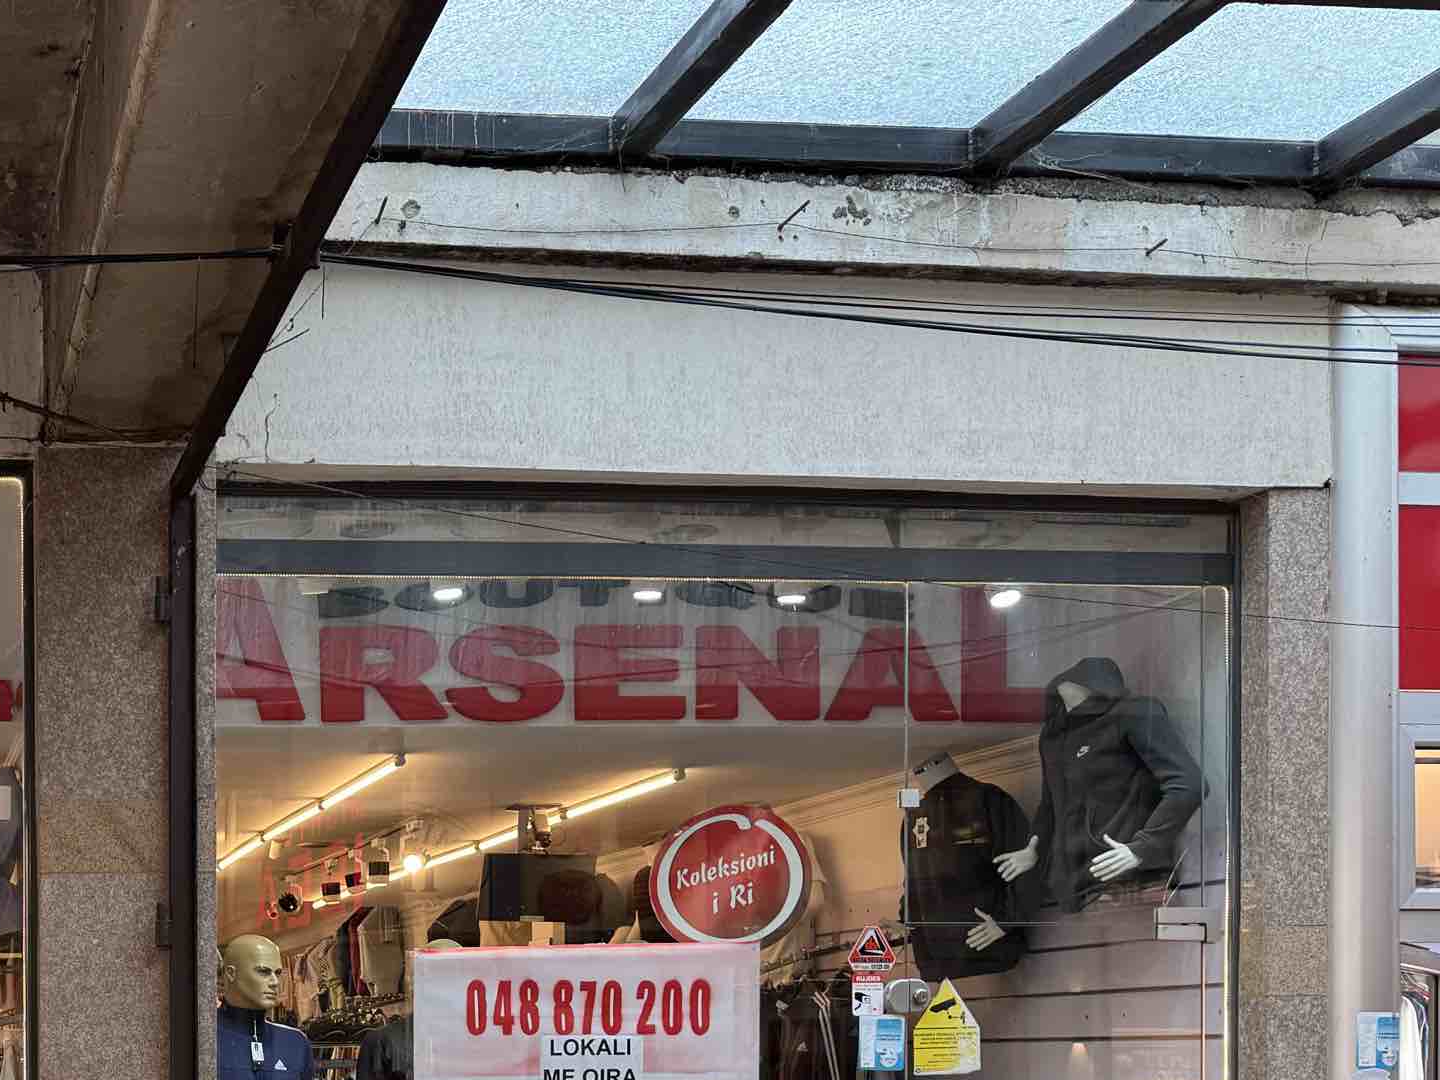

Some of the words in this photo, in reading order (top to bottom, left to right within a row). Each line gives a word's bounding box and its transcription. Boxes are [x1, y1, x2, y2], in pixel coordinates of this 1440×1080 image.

[319, 579, 914, 621] BOUTQUE
[216, 576, 1047, 722] ARSENAL
[676, 844, 776, 890] Koleksioni
[712, 892, 720, 914] i
[730, 881, 754, 909] Ri
[465, 979, 540, 1036] 048
[553, 979, 623, 1036] 870
[636, 979, 712, 1036] 200
[549, 1038, 632, 1057] LOKALI
